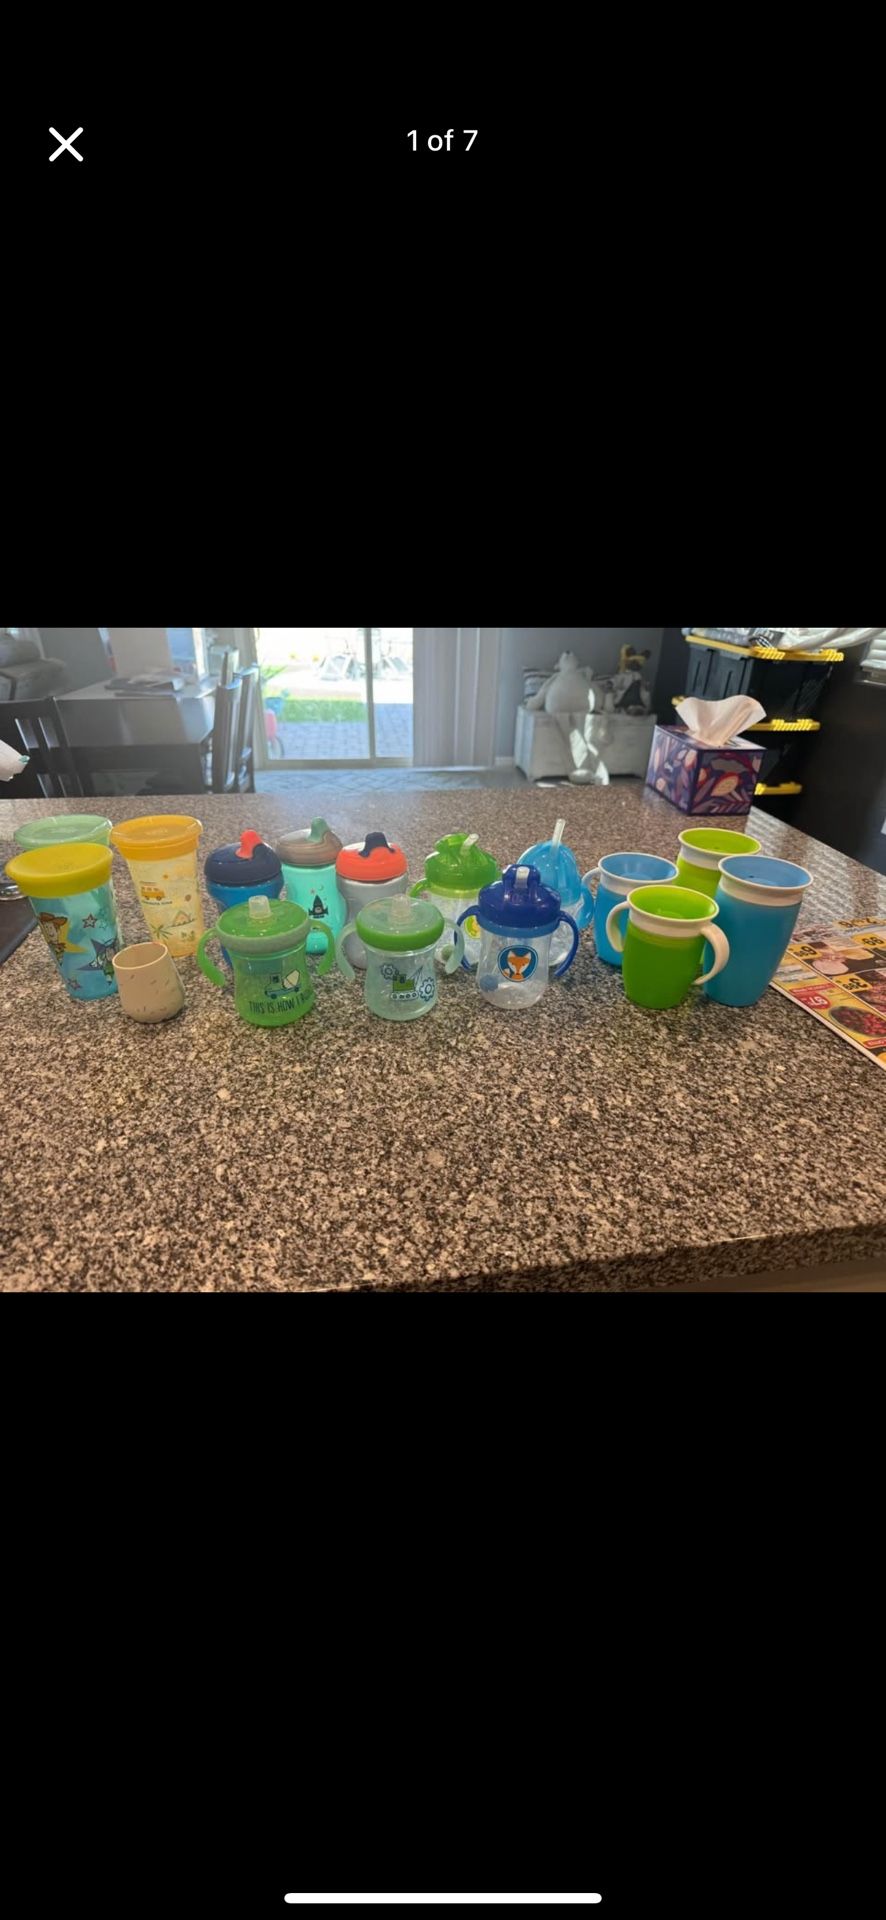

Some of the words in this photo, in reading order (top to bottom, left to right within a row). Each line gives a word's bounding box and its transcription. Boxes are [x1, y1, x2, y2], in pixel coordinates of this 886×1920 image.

[249, 1001, 265, 1014] THIS
[267, 1001, 275, 1014] IS
[277, 997, 295, 1012] HOW
